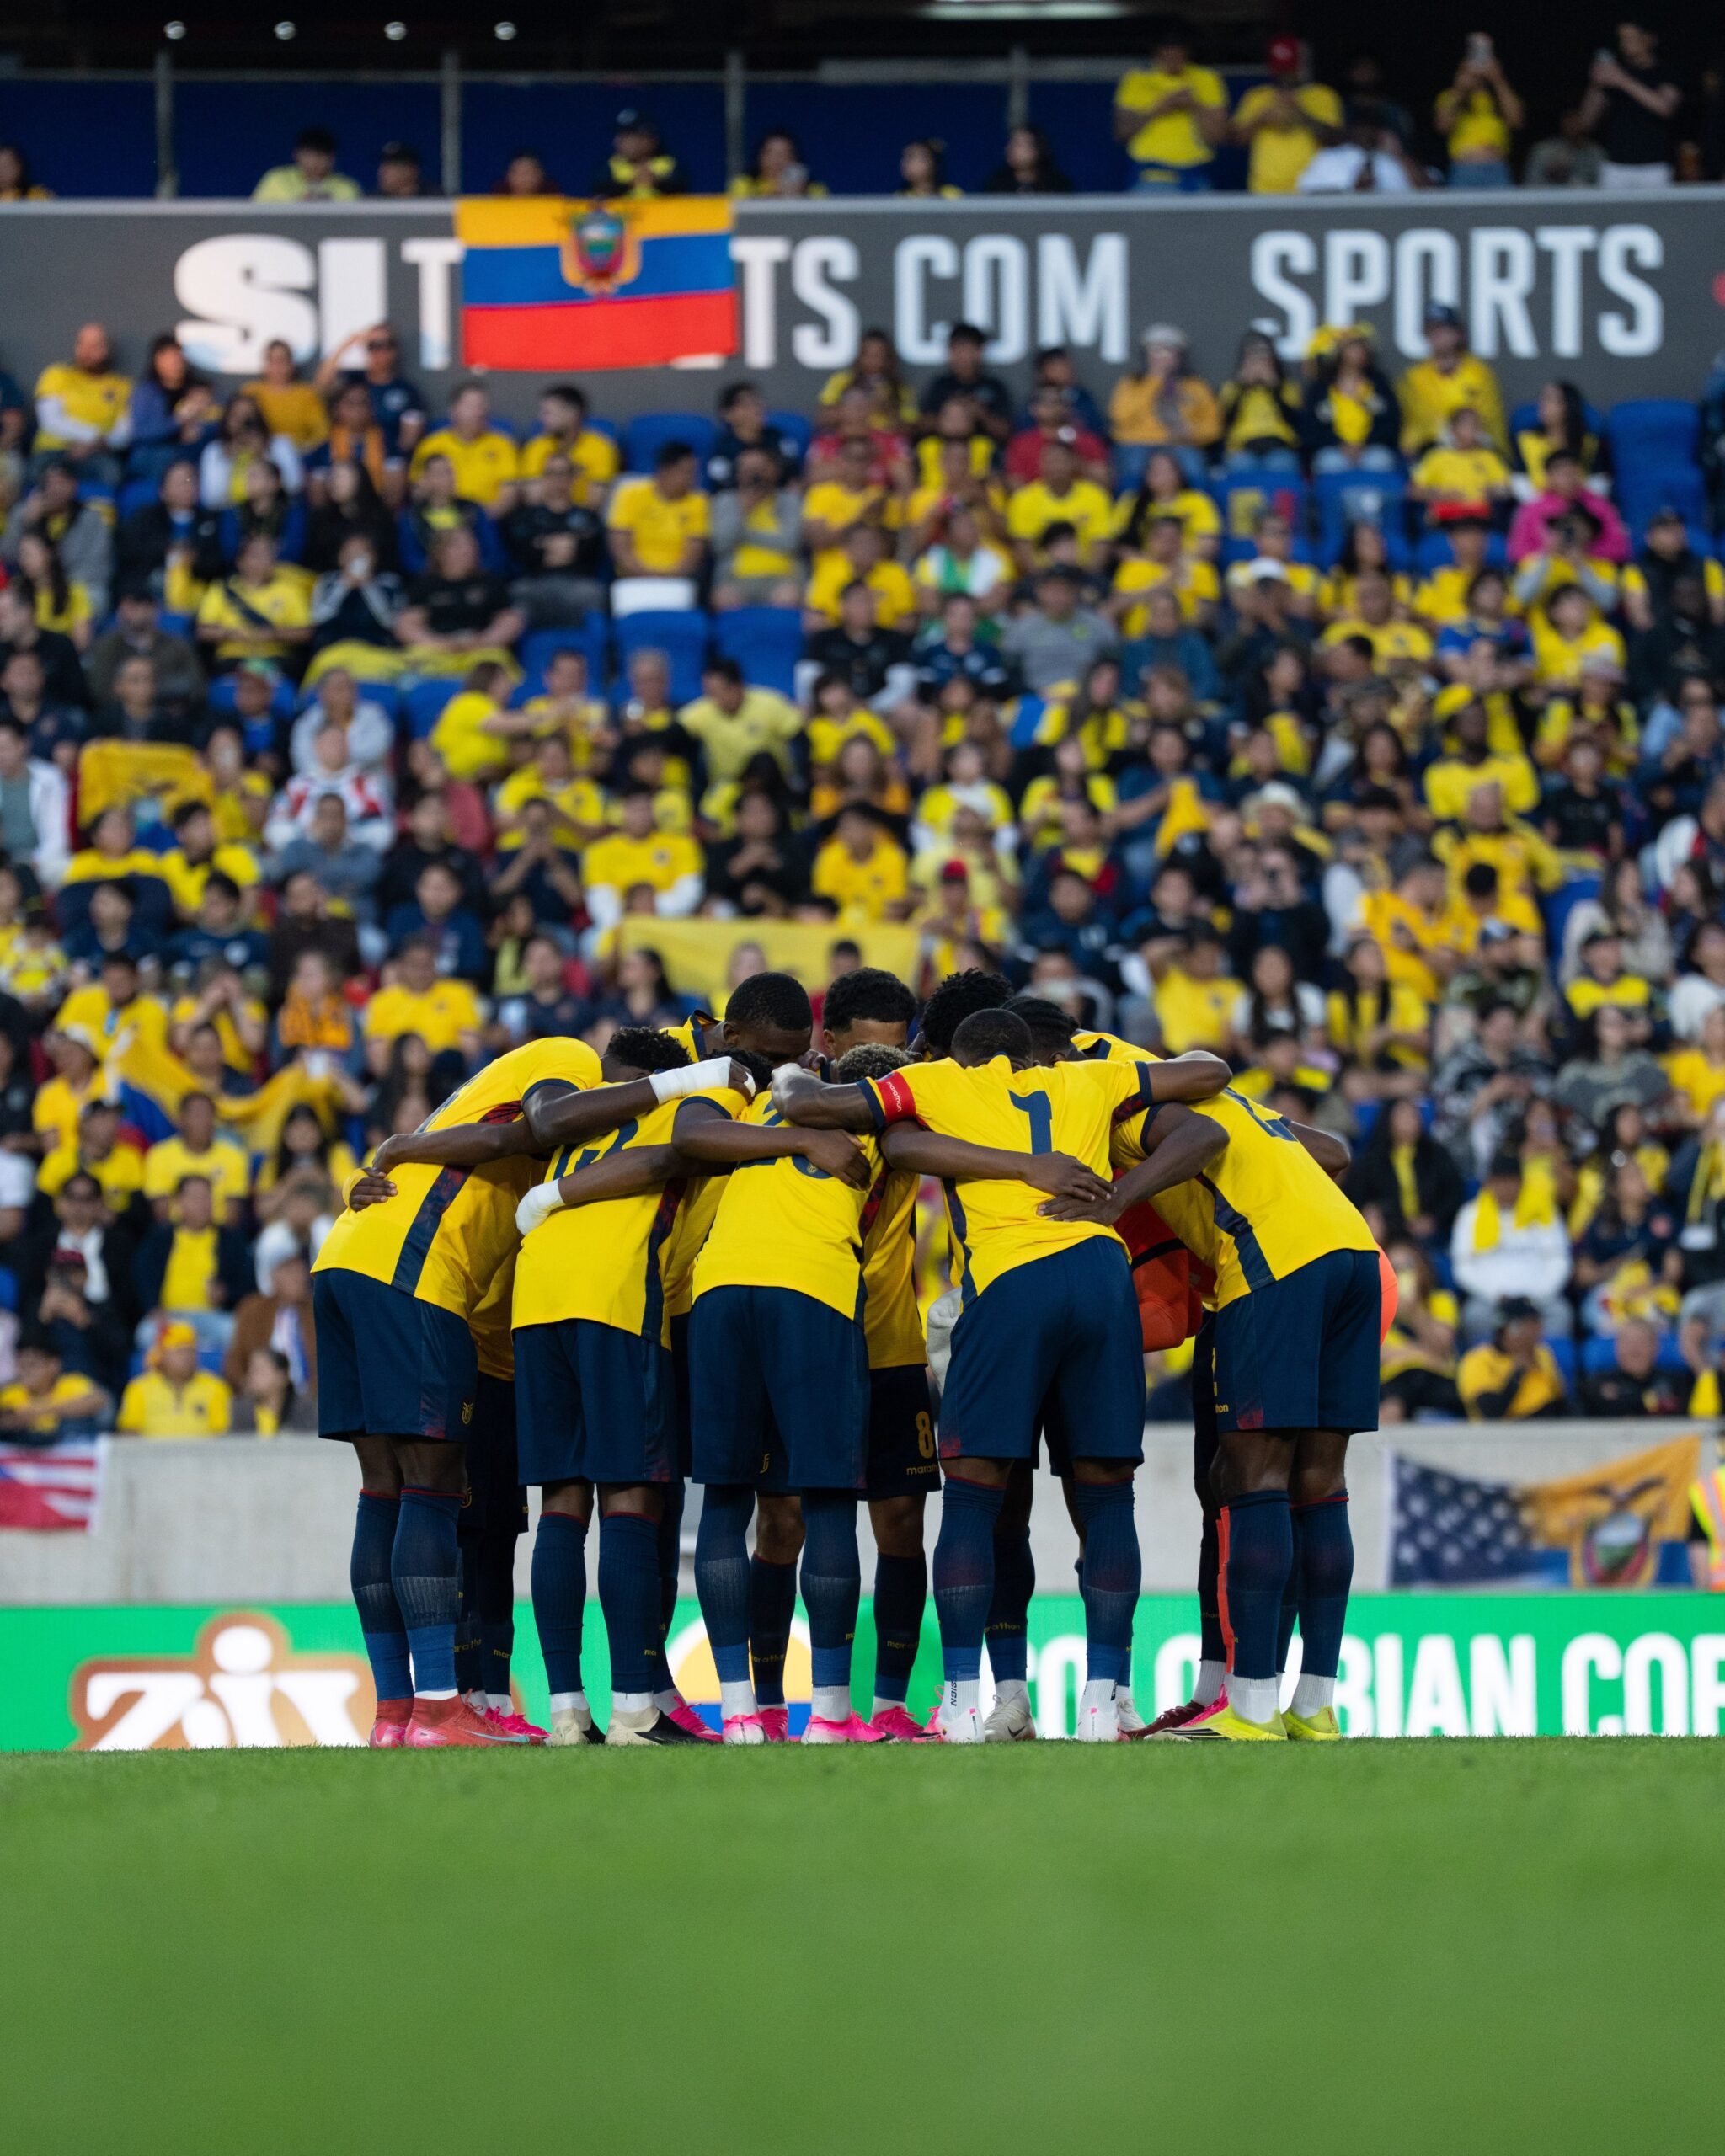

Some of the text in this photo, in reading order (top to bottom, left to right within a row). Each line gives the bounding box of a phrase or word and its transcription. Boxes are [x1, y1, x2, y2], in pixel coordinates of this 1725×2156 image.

[1250, 222, 1664, 362] SPORTS
[887, 1081, 902, 1113] marathon
[1007, 1089, 1052, 1155] 1
[916, 1411, 934, 1459] 8
[983, 1622, 1021, 1633] arathon
